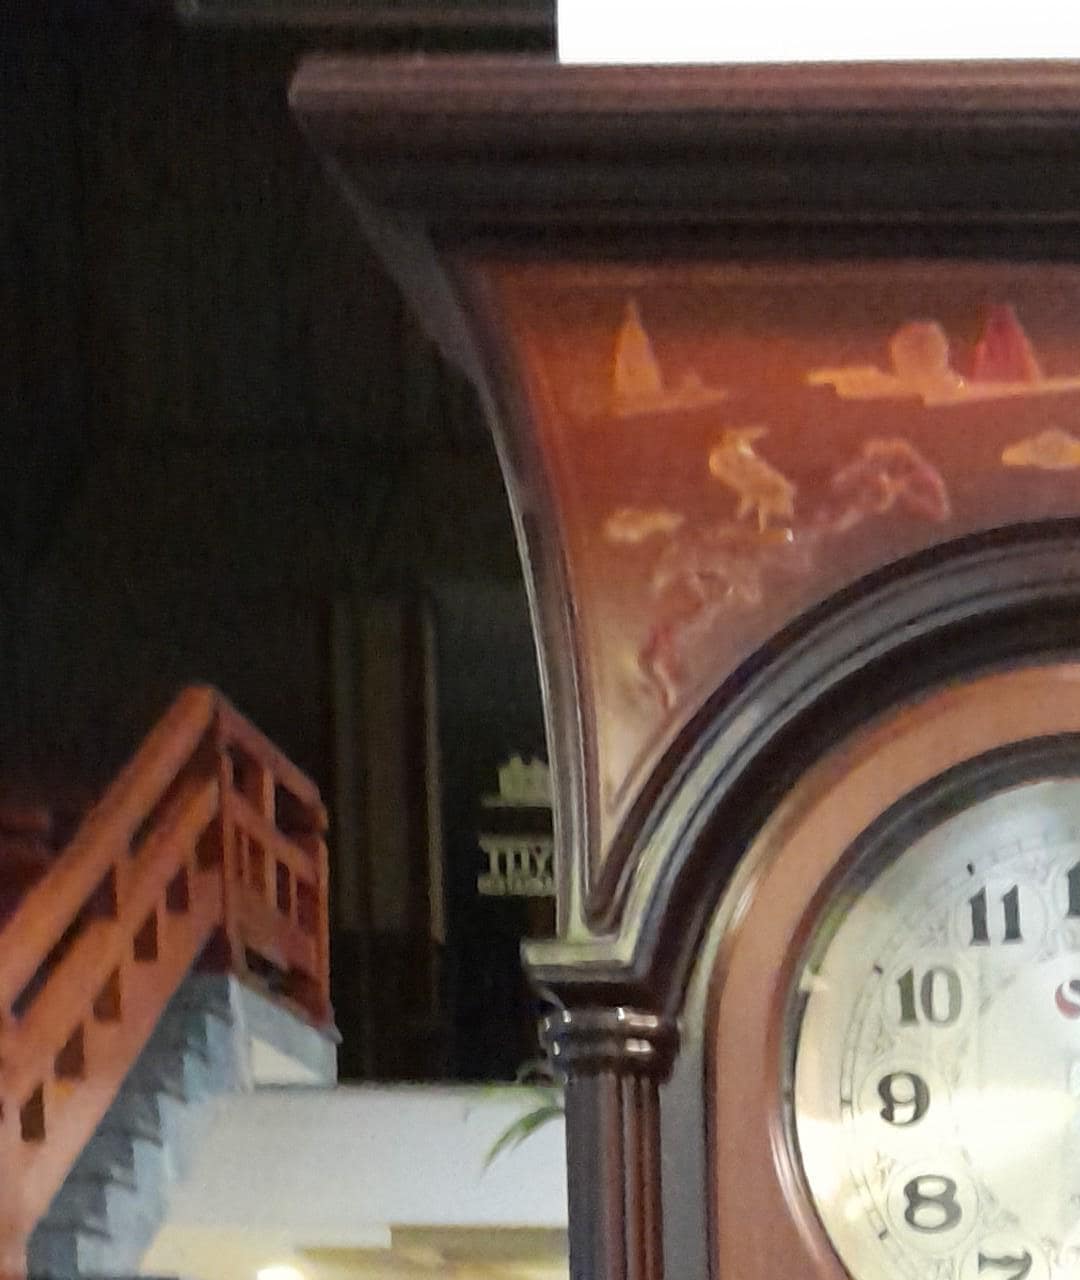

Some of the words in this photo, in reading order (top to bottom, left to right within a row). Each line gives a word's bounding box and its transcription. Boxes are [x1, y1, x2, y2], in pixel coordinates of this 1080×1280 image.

[969, 884, 1024, 946] 11
[896, 965, 962, 1027] 10
[877, 1071, 930, 1126] 9
[904, 1174, 963, 1232] 8
